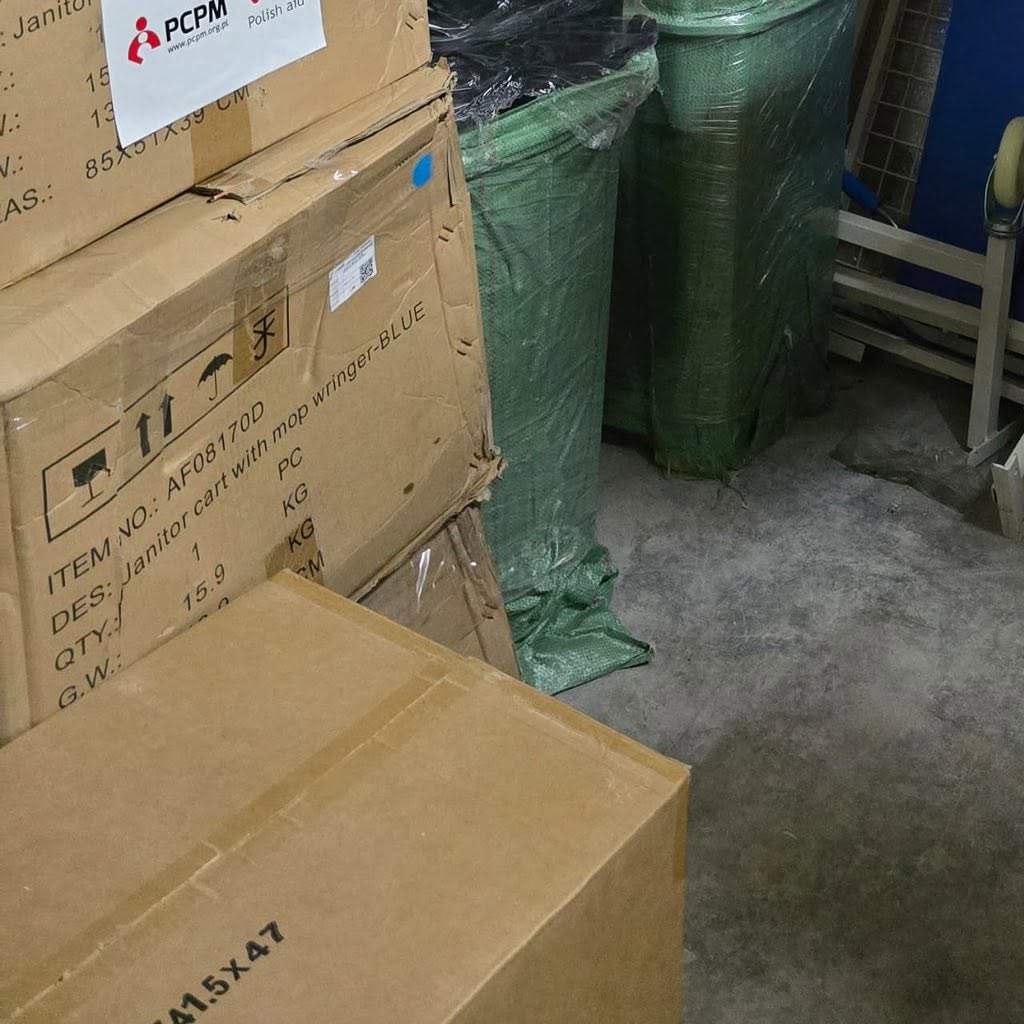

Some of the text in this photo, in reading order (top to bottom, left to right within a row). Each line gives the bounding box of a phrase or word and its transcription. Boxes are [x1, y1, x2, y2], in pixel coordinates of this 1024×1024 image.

[248, 4, 283, 29] Polish
[167, 19, 229, 54] www.pcpm.org.pl
[86, 65, 110, 92] 15
[90, 101, 115, 128] 13
[0, 184, 53, 223] AS.:
[51, 300, 426, 635] DES: Janitor cart with mop wringer-BLUE
[48, 537, 111, 595] ITEM
[167, 400, 265, 500] AF08170D
[183, 564, 226, 611] 15.9
[282, 483, 308, 518] KG
[288, 517, 315, 553] KG
[54, 446, 303, 671] QTY.: 1 PC
[153, 920, 285, 1024] 41.5X47
